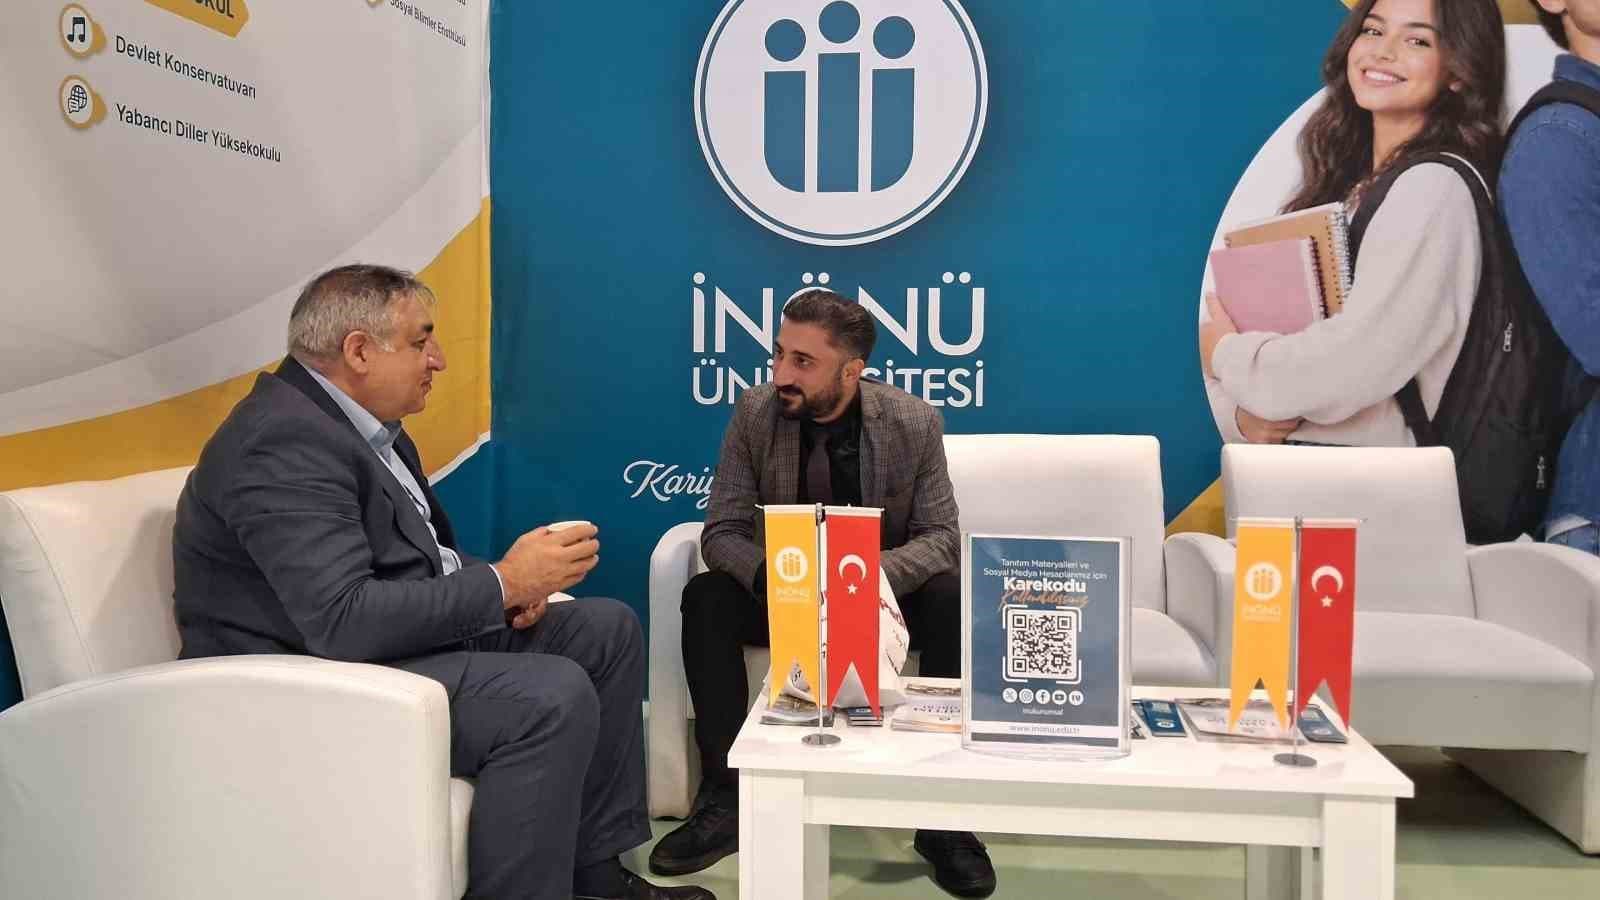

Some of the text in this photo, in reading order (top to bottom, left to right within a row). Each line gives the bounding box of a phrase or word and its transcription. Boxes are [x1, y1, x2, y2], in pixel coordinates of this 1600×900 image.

[115, 35, 256, 99] Devlet Konservatuvarı
[116, 103, 281, 162] Yabancı Diller Yüksekokulu
[1001, 558, 1029, 567] Tanıtım
[1032, 559, 1078, 569] Materyalleri
[983, 567, 1009, 577] Sosyal
[1010, 569, 1038, 578] Medya
[1003, 577, 1087, 593] Karekodu
